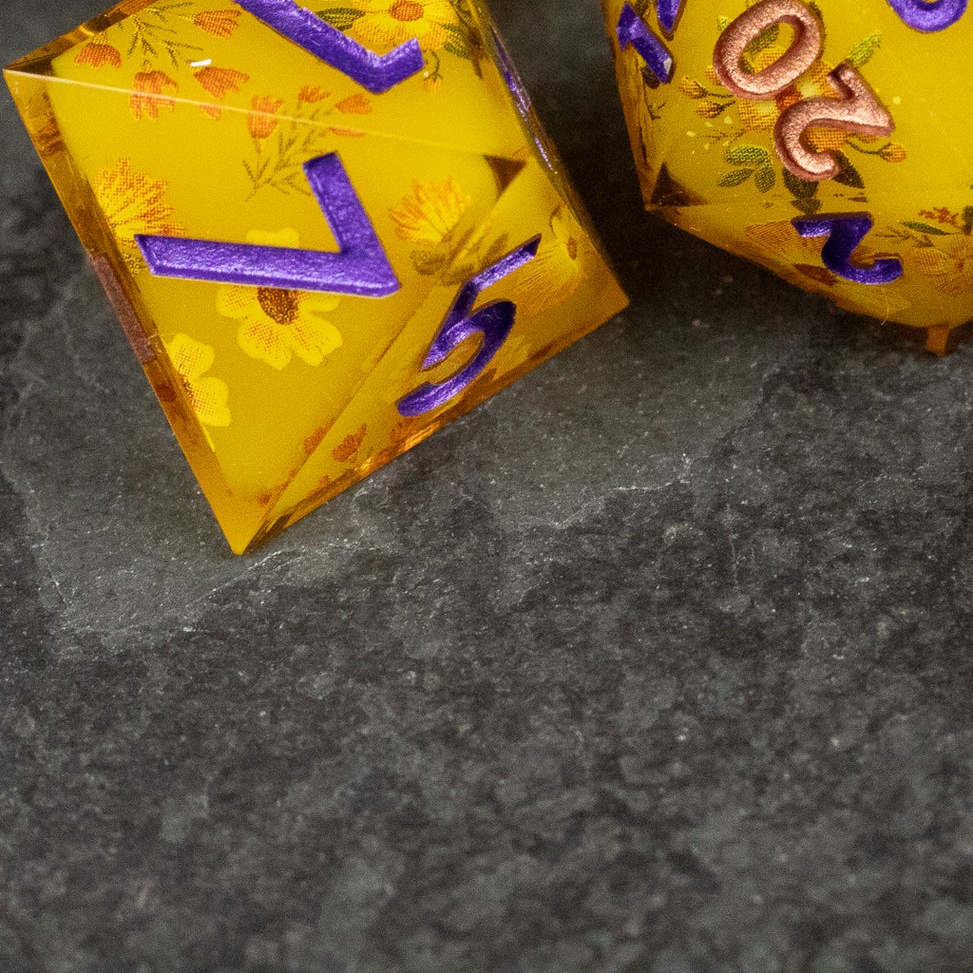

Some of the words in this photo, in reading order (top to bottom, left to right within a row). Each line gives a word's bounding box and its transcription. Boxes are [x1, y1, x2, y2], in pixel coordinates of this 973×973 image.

[135, 152, 401, 299] 7
[792, 212, 903, 287] 2
[398, 232, 542, 418] 5
